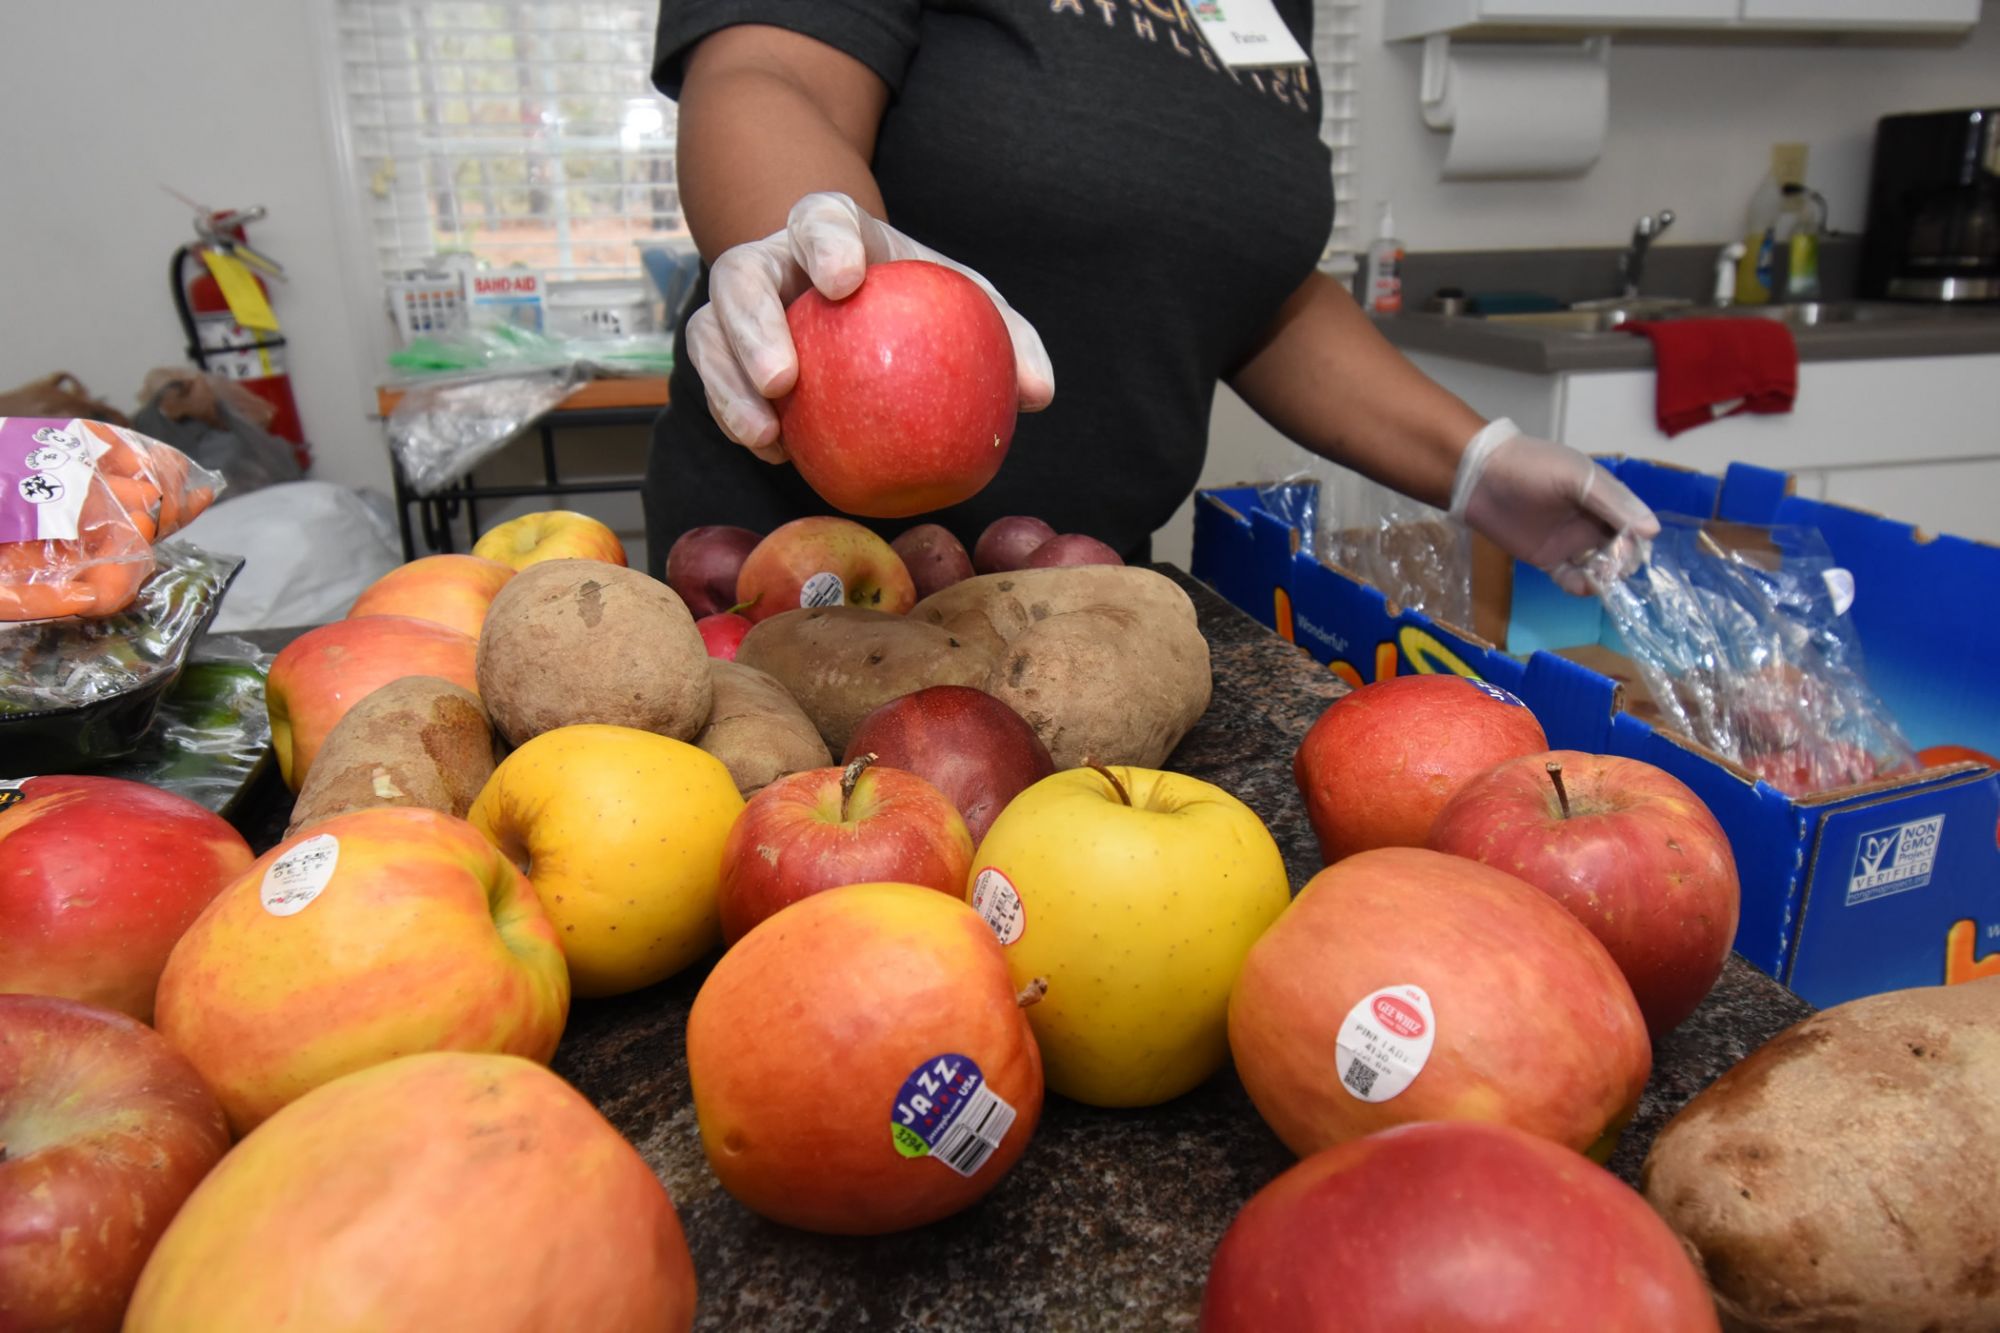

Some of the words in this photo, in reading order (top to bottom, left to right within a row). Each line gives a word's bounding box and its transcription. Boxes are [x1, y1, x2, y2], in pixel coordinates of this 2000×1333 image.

[474, 275, 536, 295] BAND-AID
[1904, 821, 1938, 841] NON
[1898, 846, 1932, 862] Project
[1901, 833, 1936, 853] GMO
[1855, 862, 1929, 889] VERIFIED
[1355, 1023, 1378, 1042] PINK
[1381, 1041, 1410, 1063] LADY
[897, 1057, 957, 1125] JAZZ
[958, 1074, 978, 1096] USA
[895, 1127, 924, 1153] 3294
